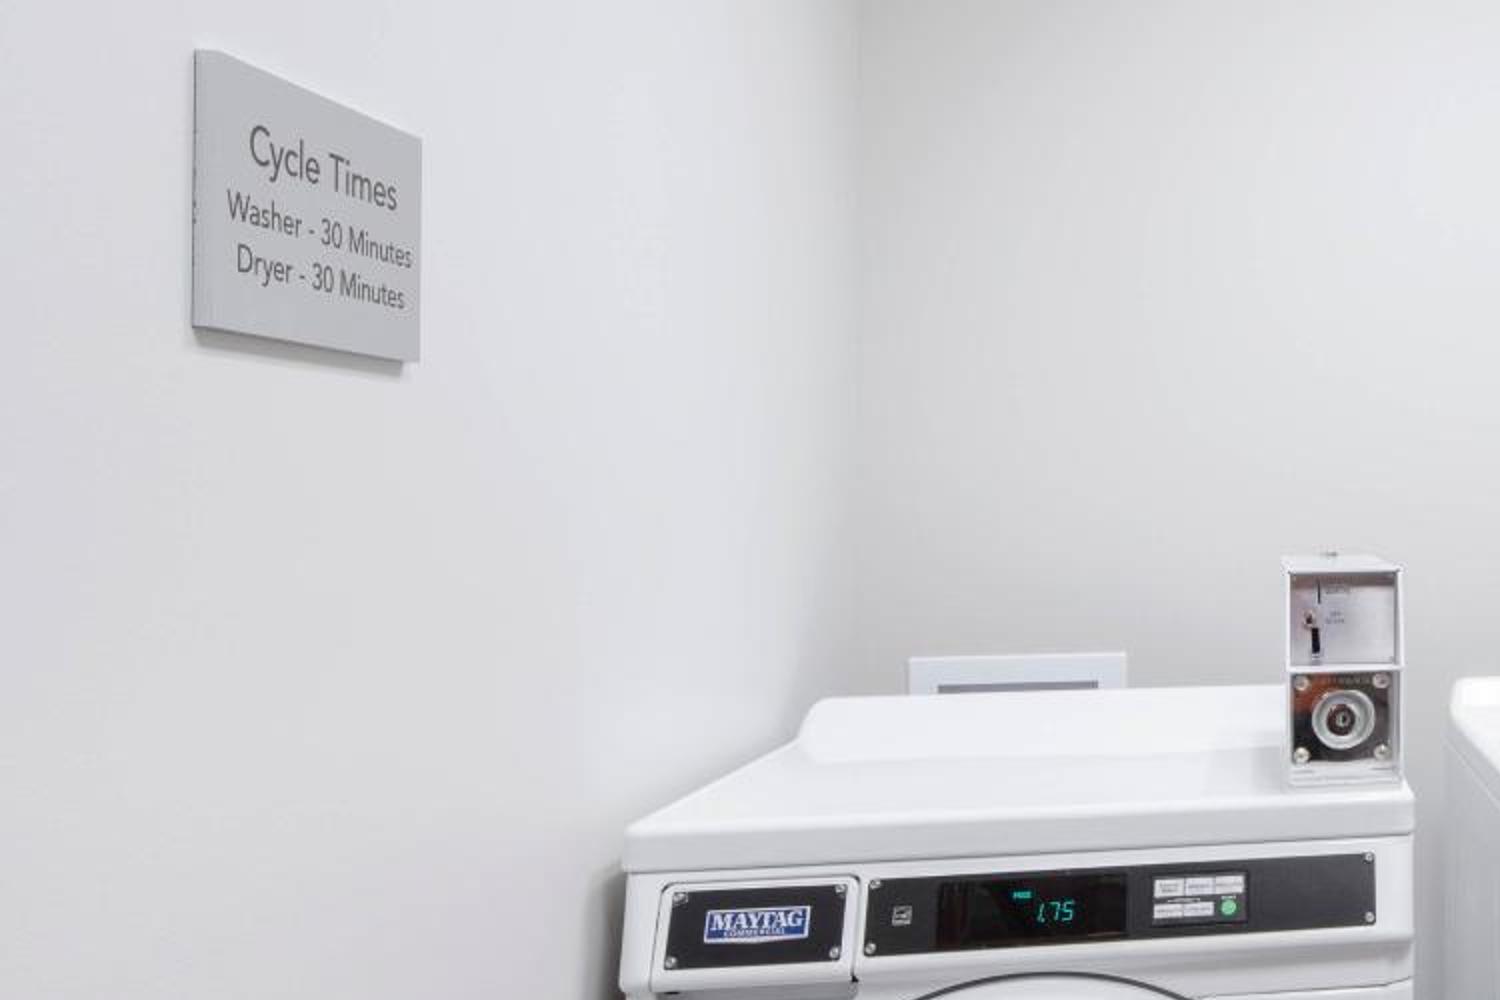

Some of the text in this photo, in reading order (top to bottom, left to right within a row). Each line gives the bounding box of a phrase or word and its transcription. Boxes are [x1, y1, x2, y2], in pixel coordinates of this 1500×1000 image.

[249, 125, 397, 211] Cycle Times
[227, 189, 302, 238] Washer
[321, 218, 342, 249] 30
[349, 226, 412, 268] Minutes
[237, 244, 293, 288] Dryer
[312, 263, 333, 294] 30
[340, 270, 405, 309] Minutes
[709, 910, 805, 931] MAYTAG
